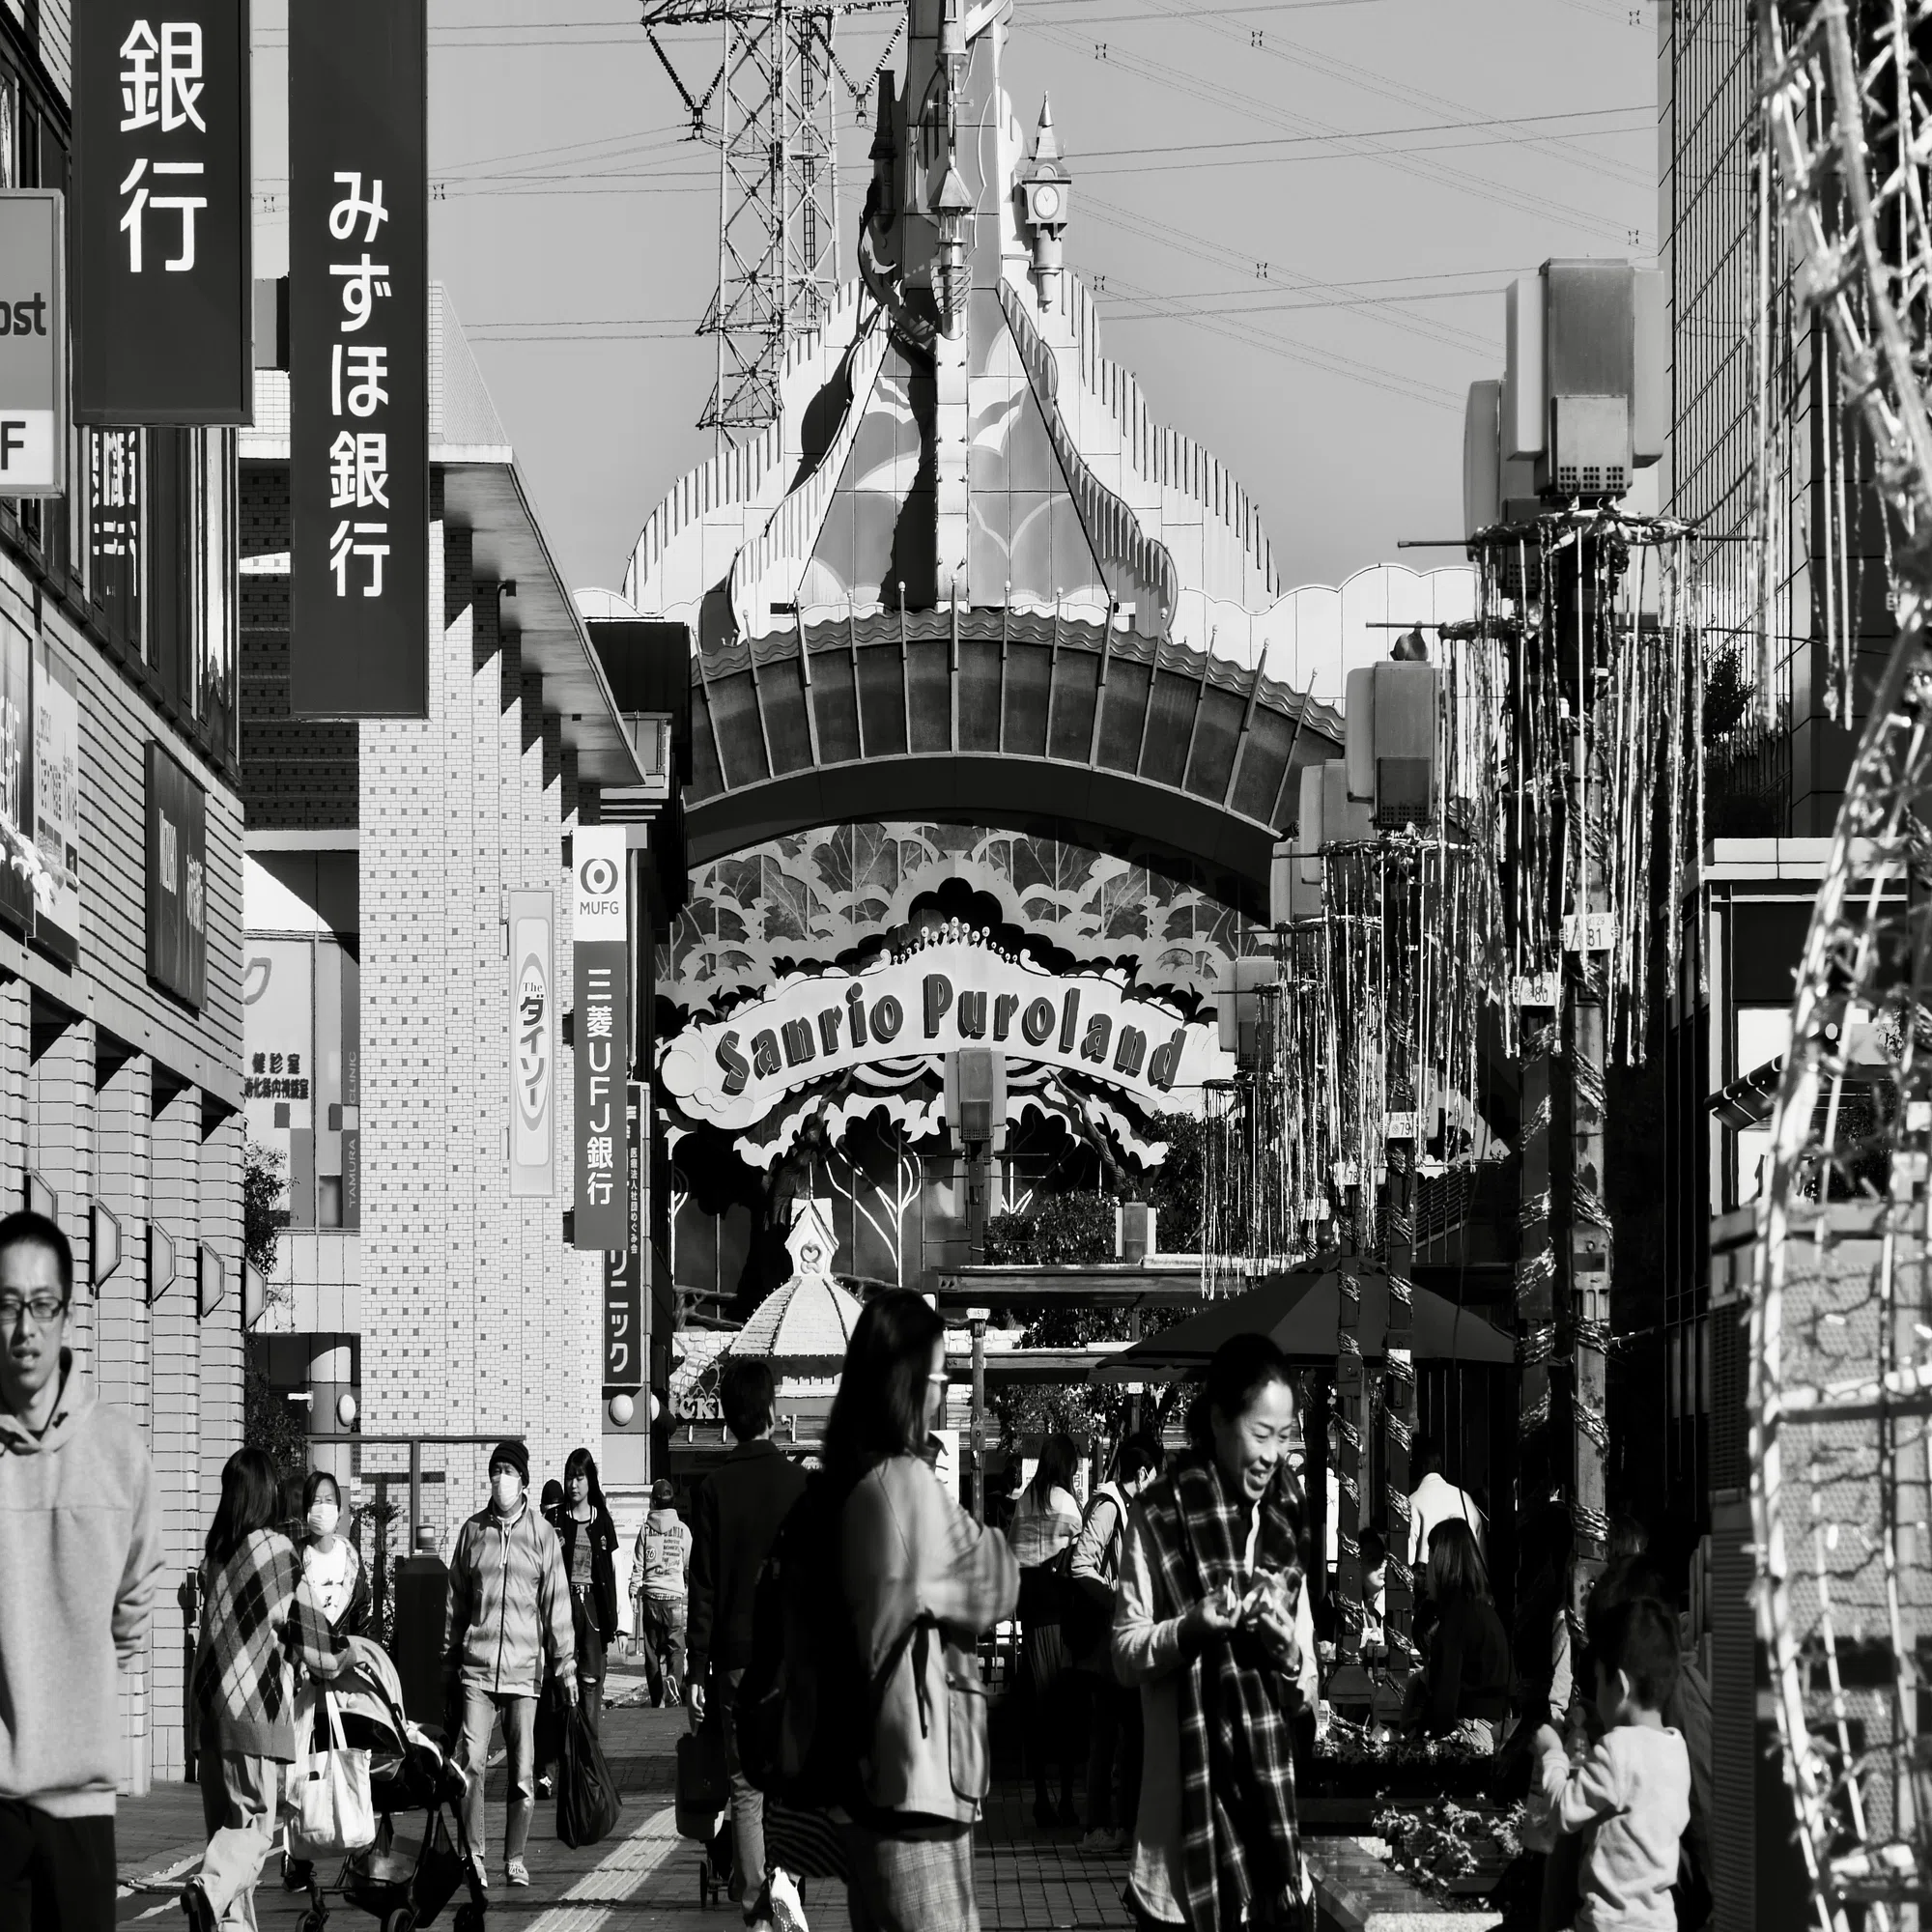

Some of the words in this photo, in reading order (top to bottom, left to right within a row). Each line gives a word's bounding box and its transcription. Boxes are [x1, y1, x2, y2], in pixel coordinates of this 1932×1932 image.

[119, 19, 208, 273] 銀行
[329, 171, 391, 597] みずほ銀行
[580, 900, 619, 916] MUFG
[524, 981, 543, 992] The
[715, 982, 903, 1095] Sanrio
[923, 974, 1187, 1093] Puroland
[520, 993, 545, 1107] ダイソー
[586, 968, 614, 1206] 三菱UFJ銀行
[348, 1138, 356, 1208] TAMURA
